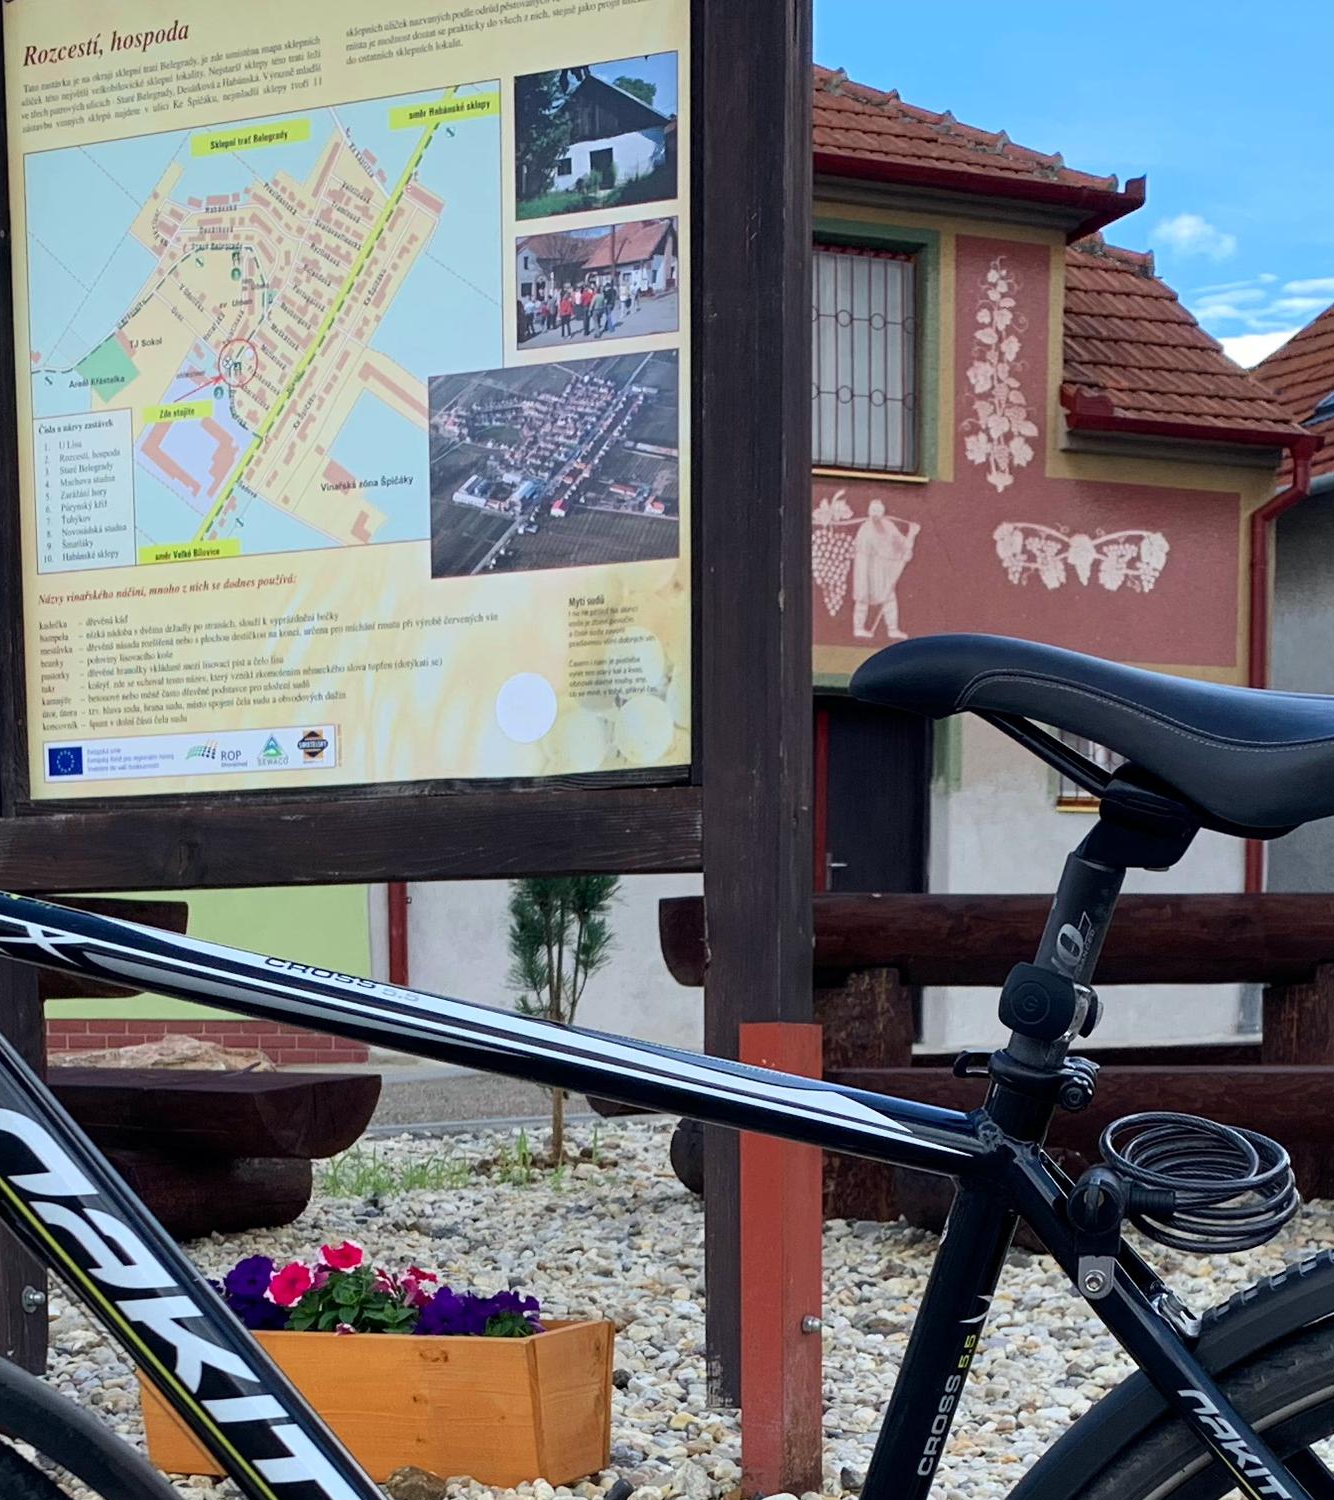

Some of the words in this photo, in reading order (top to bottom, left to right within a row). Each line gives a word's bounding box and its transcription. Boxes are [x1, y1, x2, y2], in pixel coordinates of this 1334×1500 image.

[22, 32, 103, 67] Rozcestí,
[109, 18, 189, 52] hospoda
[429, 103, 465, 117] Habánské
[466, 99, 491, 113] sklepy
[210, 137, 235, 150] Sklepní
[253, 131, 289, 146] Belegrady
[141, 337, 163, 348] Sokol
[159, 409, 172, 419] Zde
[320, 481, 357, 492] Vinařská
[358, 480, 379, 490] zóna
[380, 475, 414, 488] Špičáky
[173, 550, 192, 560] Velké
[37, 593, 63, 606] Názvy
[66, 588, 113, 602] vinařského
[148, 583, 180, 595] mnoho
[189, 579, 209, 592] nich
[222, 577, 255, 589] dodnes
[221, 750, 242, 761] ROP
[264, 956, 377, 990] CROSS
[917, 1374, 961, 1476] CROSS
[957, 1334, 977, 1369] 5.5
